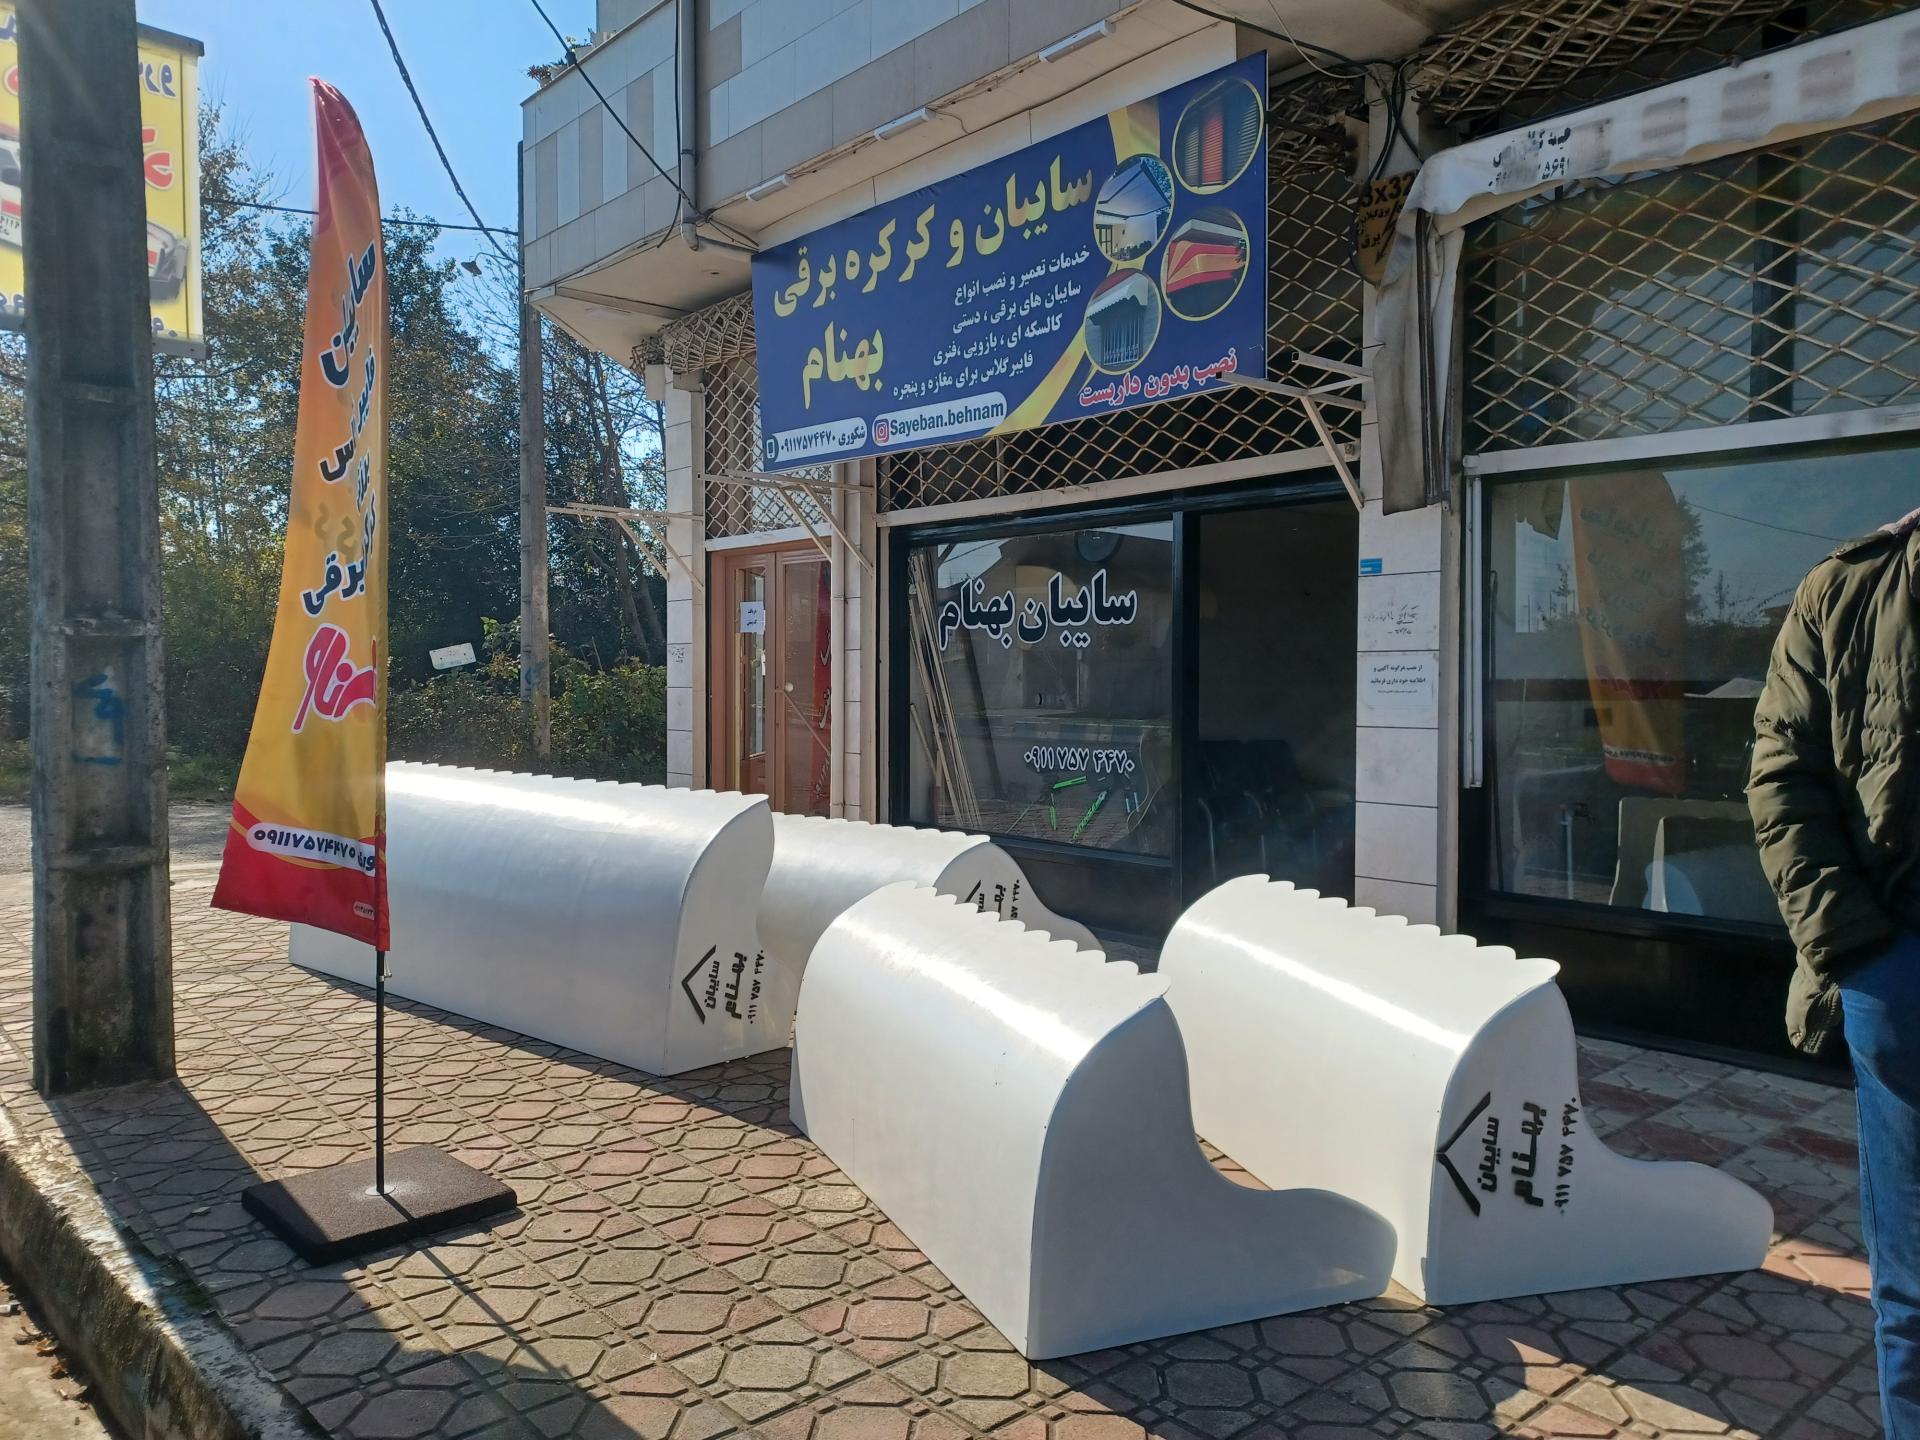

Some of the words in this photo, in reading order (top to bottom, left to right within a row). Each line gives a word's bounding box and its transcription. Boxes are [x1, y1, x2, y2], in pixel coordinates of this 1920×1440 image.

[975, 154, 1093, 255] سایبان
[845, 203, 935, 293] کرکره
[946, 218, 964, 268] و
[1048, 244, 1090, 272] خدمات
[774, 246, 837, 317] برقی
[982, 272, 1006, 297] نصب
[1009, 274, 1016, 291] و
[1018, 259, 1046, 289] تعمیر
[954, 279, 979, 306] انواع
[1020, 291, 1041, 316] های
[1045, 279, 1081, 309] سایبان
[952, 311, 980, 334] دستی
[990, 298, 1016, 324] برقی
[1024, 313, 1063, 338] کالسکه
[802, 320, 884, 410] بهنام
[955, 366, 978, 388] برای
[1193, 347, 1238, 386] نصب
[893, 377, 918, 400] پنجره
[927, 371, 952, 393] مغازه
[1079, 372, 1141, 406] داربست
[1144, 365, 1190, 398] بدون
[890, 402, 1004, 436] Sayeban.behnam
[780, 431, 836, 453] ۰۹۱۱۷۵۷۴۴۷۰
[838, 428, 866, 447] شکوری
[302, 552, 364, 615] برقی
[938, 578, 1016, 650] بهنام
[1017, 568, 1137, 648] سایبان
[1024, 746, 1055, 769] ۰۹۱۱
[1056, 746, 1090, 771] ۷۵۷
[1093, 750, 1135, 773] ۴۴۷۰
[254, 829, 356, 858] ۰۹۱۱۷۵۷۴۴۷۰
[754, 949, 765, 975] ۴۴۷۰
[704, 960, 720, 1009] سایبان
[724, 952, 748, 1019] بهنام
[750, 979, 761, 1000] ۷۵۷
[1562, 1097, 1579, 1136] ۴۴۷۰
[1477, 1116, 1501, 1192] سایبان
[1511, 1101, 1547, 1207] بهنام
[1557, 1144, 1574, 1177] ۷۵۷
[1554, 1184, 1571, 1215] ۰۹۱۱
